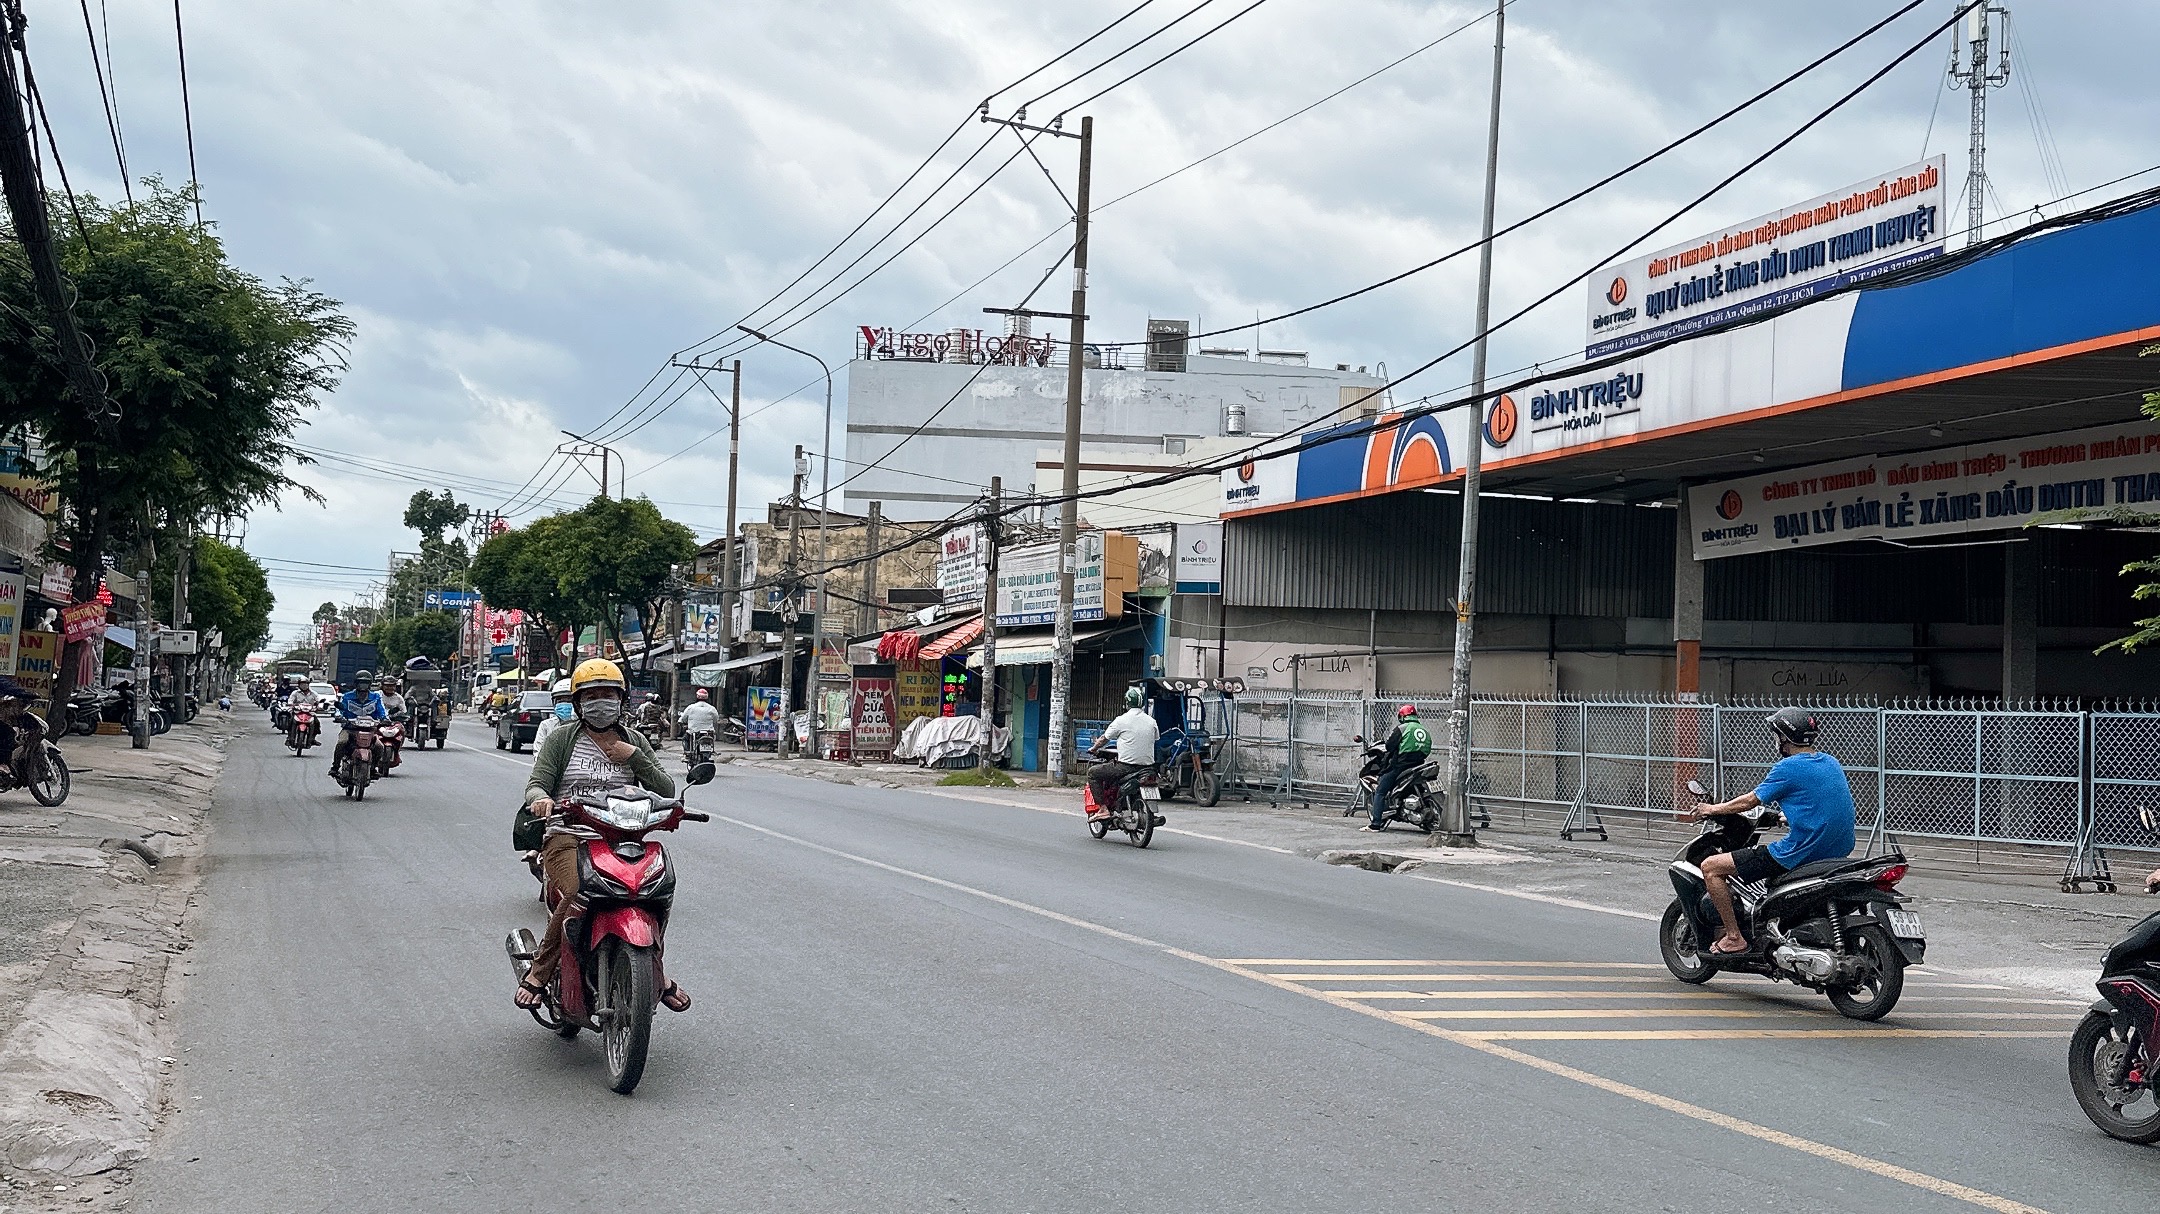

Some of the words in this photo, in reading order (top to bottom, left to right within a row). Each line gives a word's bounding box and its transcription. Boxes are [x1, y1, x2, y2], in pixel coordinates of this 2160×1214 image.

[1680, 249, 1699, 269] TNHH
[1890, 176, 1917, 202] XĂNG
[1645, 291, 1665, 320] ĐẠI
[1666, 281, 1680, 312] LÝ
[1680, 276, 1706, 307] BÁN
[1707, 264, 1723, 299] LẺ
[1725, 261, 1759, 292] XĂNG
[1789, 240, 1825, 275] DNTN
[1828, 226, 1873, 263] THANH
[1875, 204, 1936, 249] NGUYỆT
[857, 326, 951, 356] Virgo
[960, 328, 1058, 356] Hotel
[1531, 388, 1578, 421] BÌNH
[1579, 371, 1643, 410] TRIỆU
[1800, 479, 1818, 496] TY
[1821, 472, 1856, 492] TNHH
[1922, 460, 1957, 482] BÌNH
[1961, 452, 2006, 477] TRIỆU
[2019, 443, 2086, 469] THƯƠNG
[2090, 435, 2141, 461] NHÂN
[1774, 511, 1809, 544] ĐẠI
[1812, 501, 1837, 534] LÝ
[1841, 497, 1881, 530] BÁN
[1885, 492, 1914, 528] LẺ
[1919, 492, 1981, 525] XĂNG
[2038, 478, 2105, 513] DNTN
[1772, 666, 1807, 686] CẤM
[856, 715, 873, 724] CAO
[863, 699, 886, 712] CỬA
[581, 759, 621, 772] LIVING
